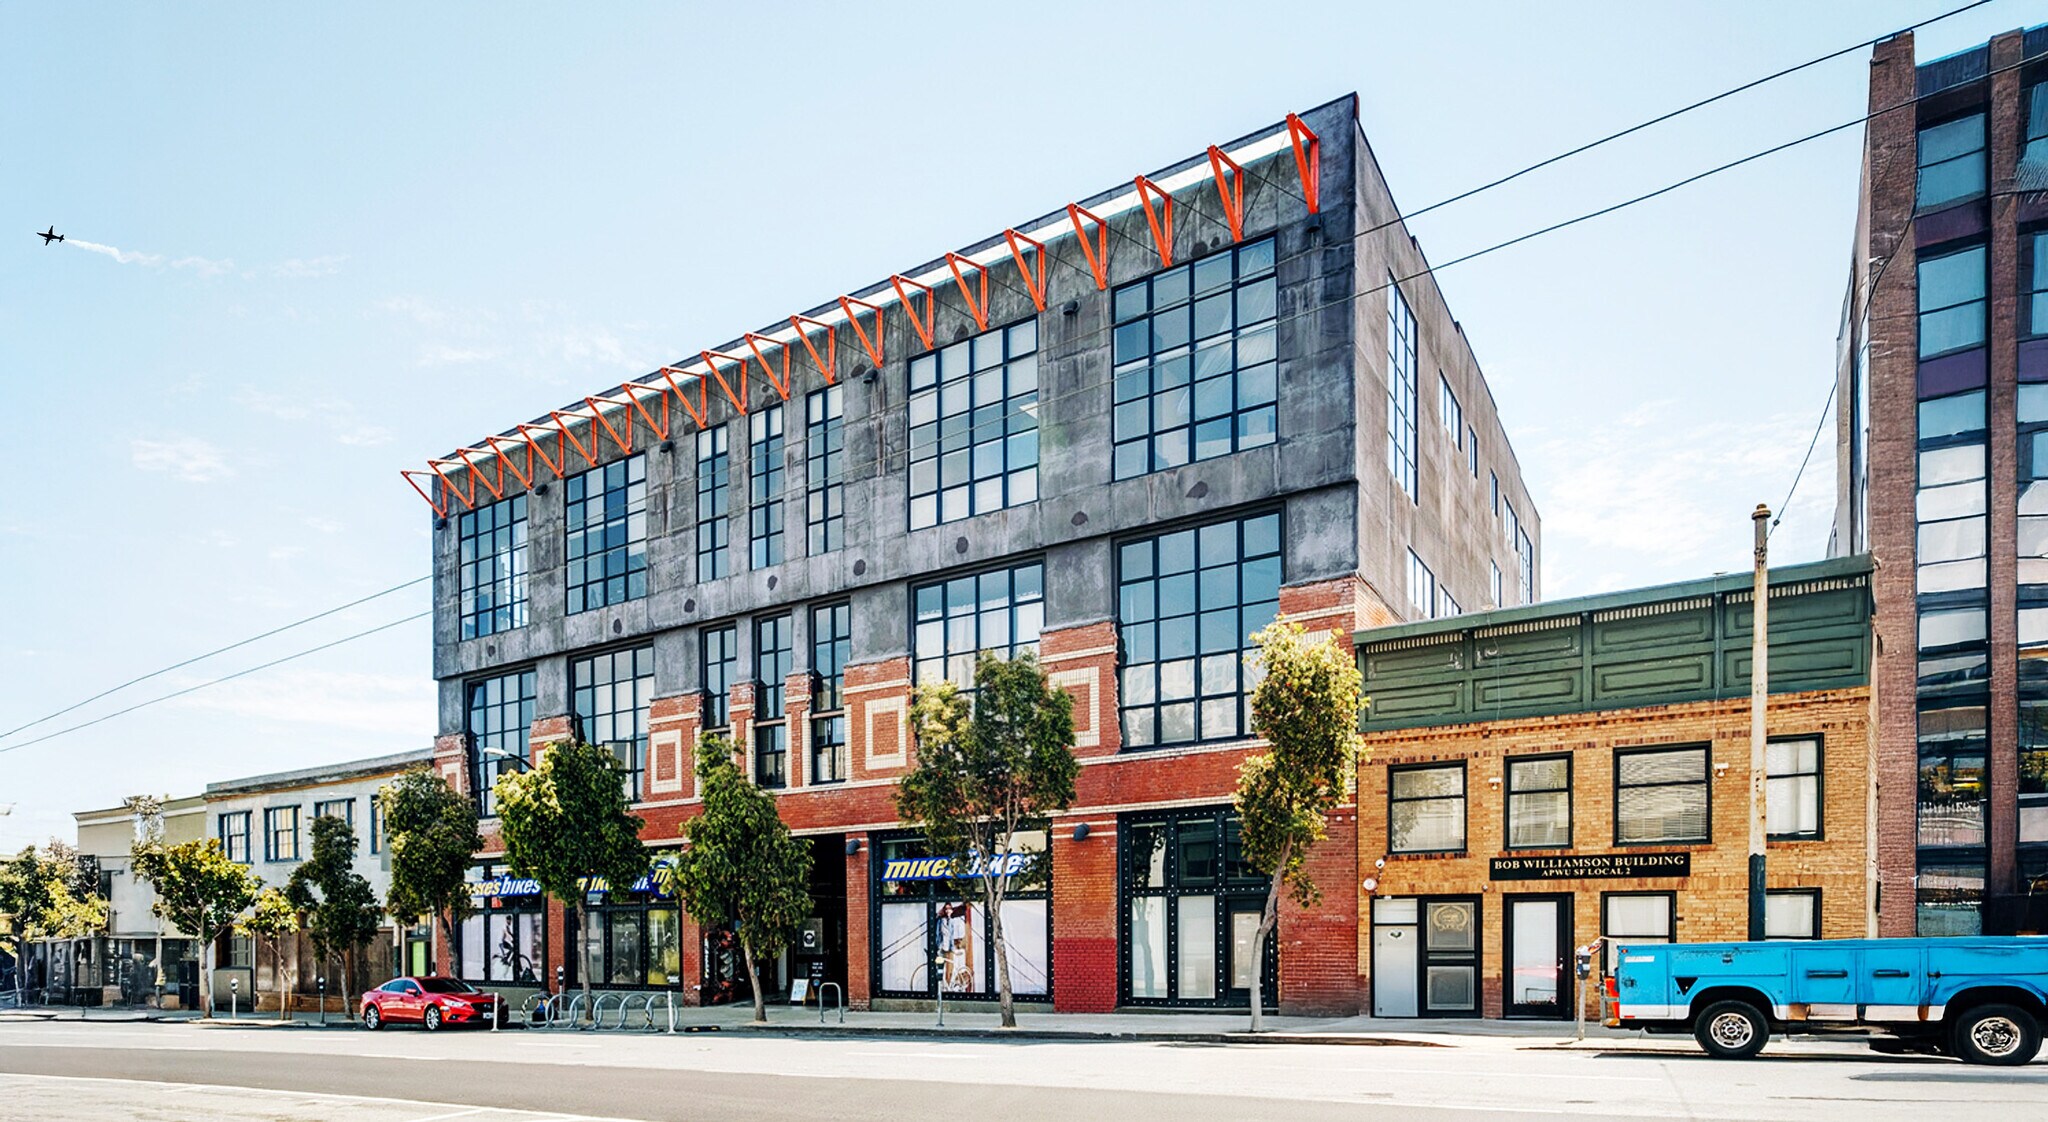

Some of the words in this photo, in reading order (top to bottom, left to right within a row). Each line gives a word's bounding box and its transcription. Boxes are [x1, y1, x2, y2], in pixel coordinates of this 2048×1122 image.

[1494, 860, 1520, 870] BOB
[1523, 857, 1611, 869] WILLIAMSON
[1615, 855, 1685, 867] BUILDING
[1541, 869, 1571, 877] APWU
[1573, 868, 1585, 876] SF
[1587, 867, 1624, 876] LOCAL
[1625, 867, 1632, 875] 2
[500, 875, 541, 895] bikes
